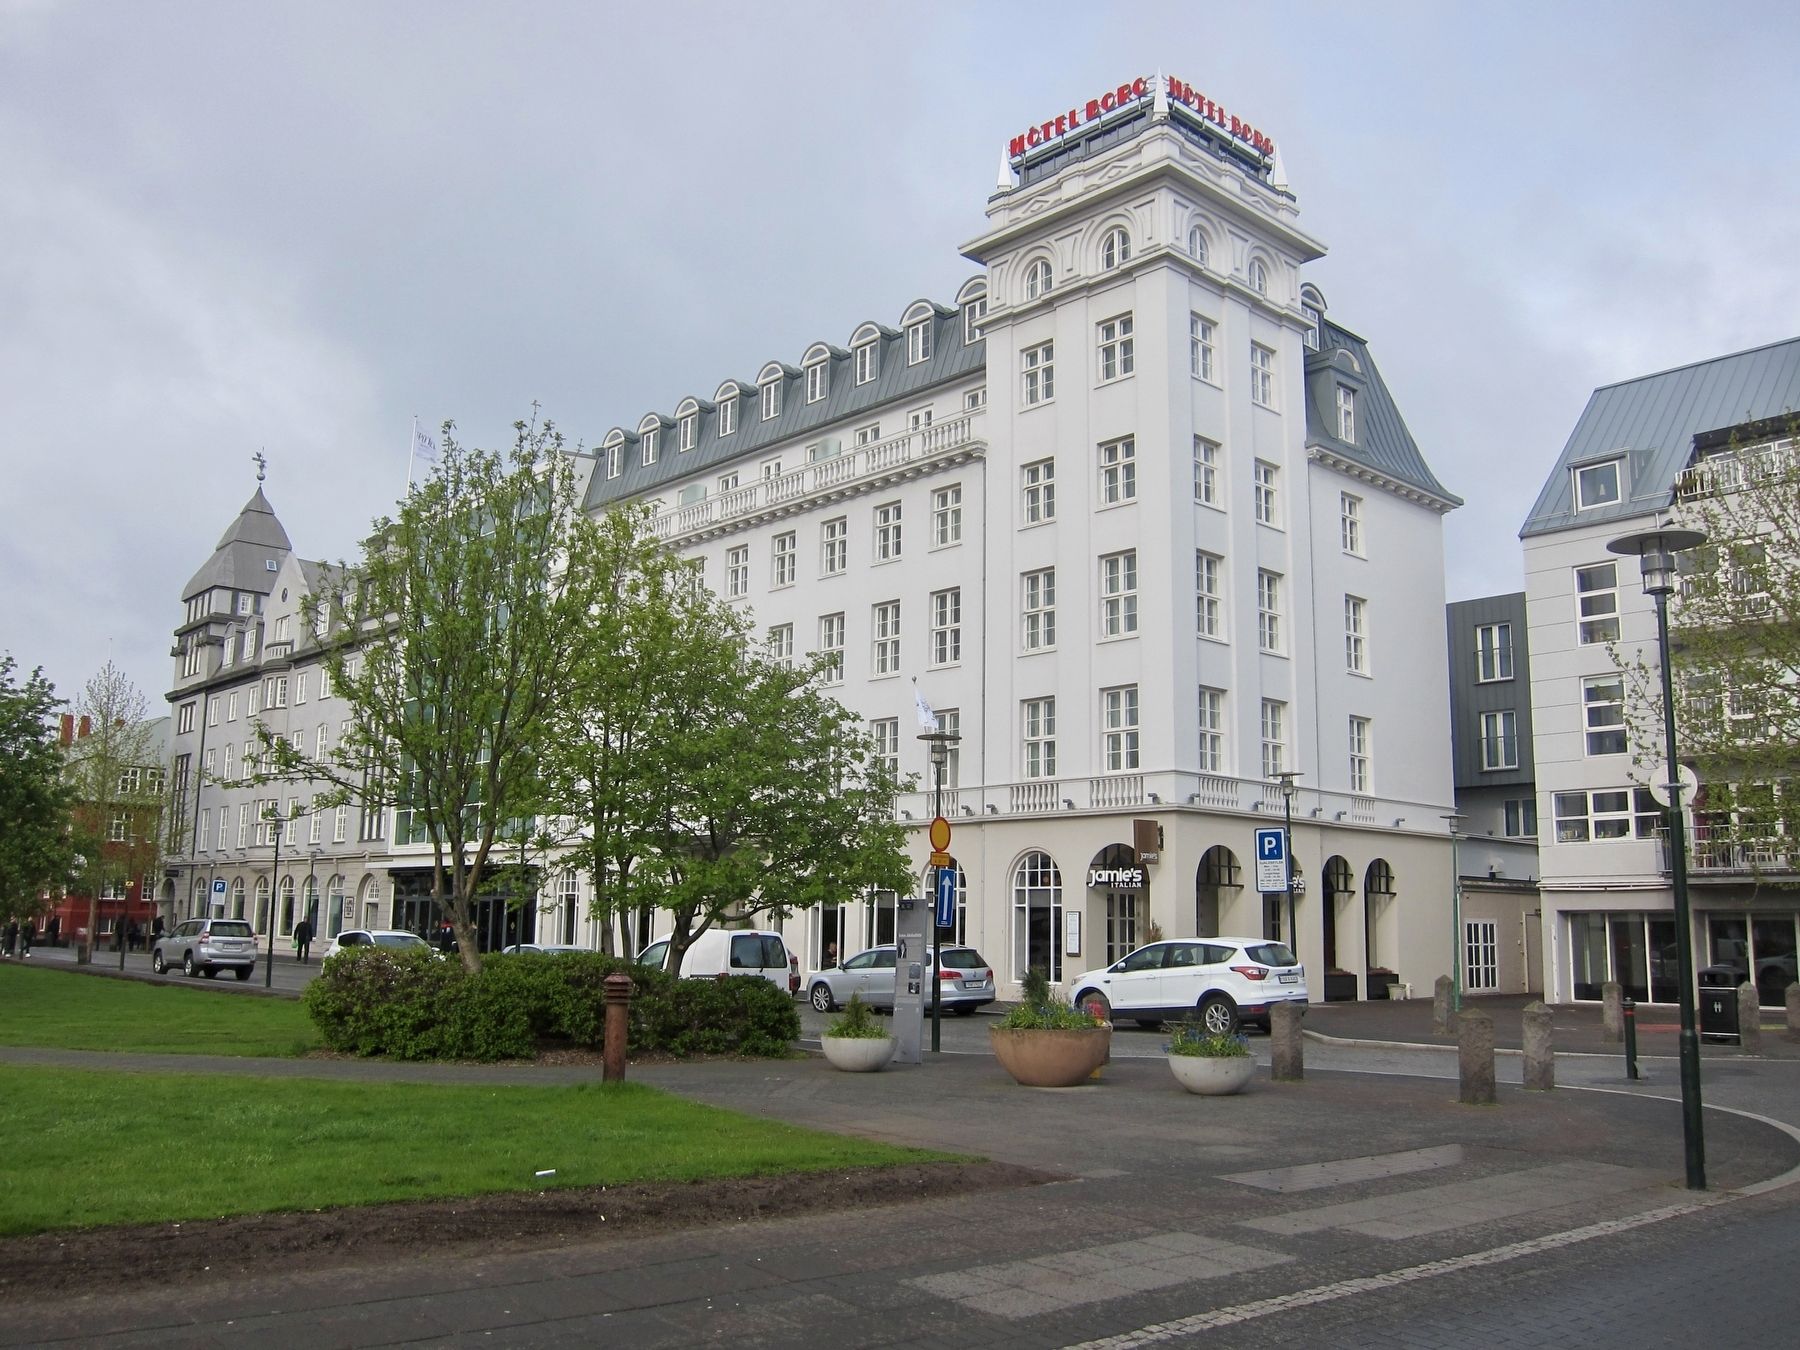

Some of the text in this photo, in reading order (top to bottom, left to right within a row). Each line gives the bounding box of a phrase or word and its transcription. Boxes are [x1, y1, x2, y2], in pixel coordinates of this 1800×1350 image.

[1086, 77, 1147, 121] BORG
[1231, 115, 1274, 156] BORG
[1264, 836, 1277, 855] P
[216, 883, 224, 891] P
